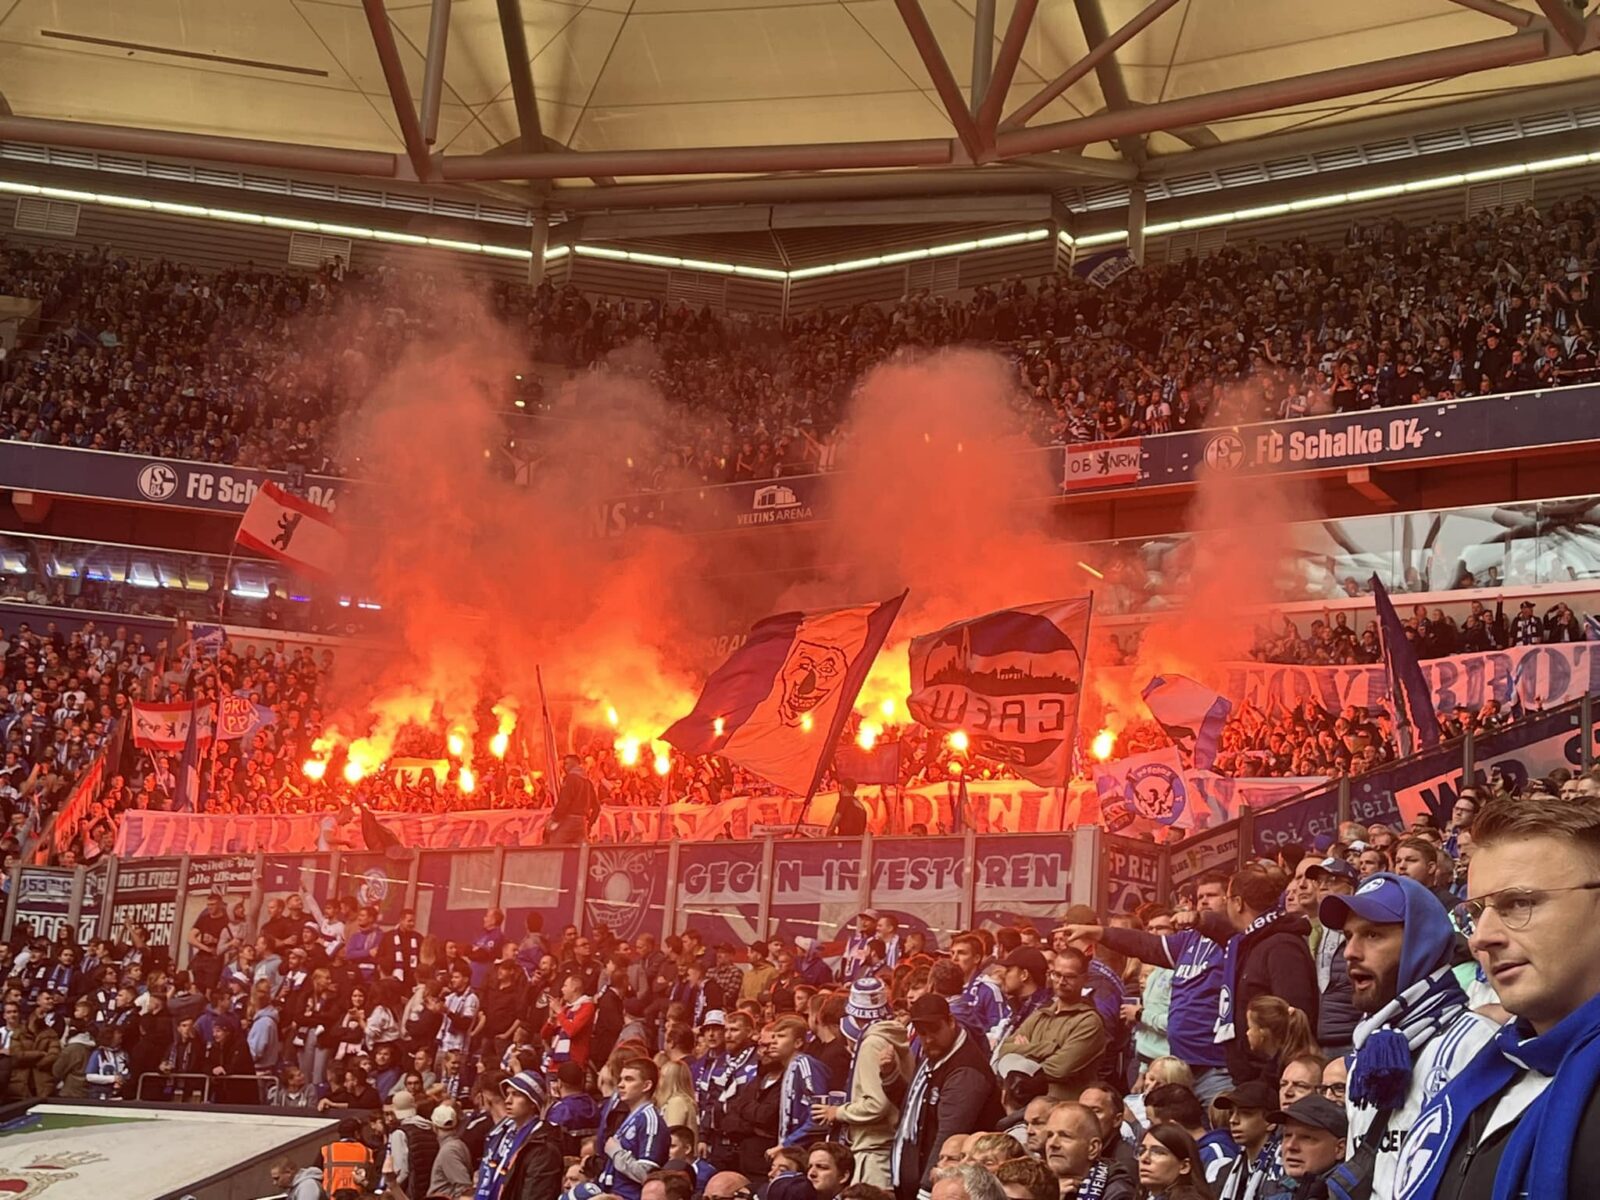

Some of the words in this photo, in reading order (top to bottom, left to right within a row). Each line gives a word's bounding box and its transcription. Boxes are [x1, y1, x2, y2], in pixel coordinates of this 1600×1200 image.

[1257, 433, 1283, 464] FC
[1290, 425, 1382, 461] Schalke
[1389, 418, 1423, 451] 04
[1071, 459, 1092, 475] OB
[1109, 451, 1140, 469] NRW
[186, 473, 214, 500] FC
[737, 510, 775, 525] VELTINS
[776, 507, 813, 521] ARENA
[683, 860, 802, 894] GEGN
[112, 903, 158, 924] HERTHA
